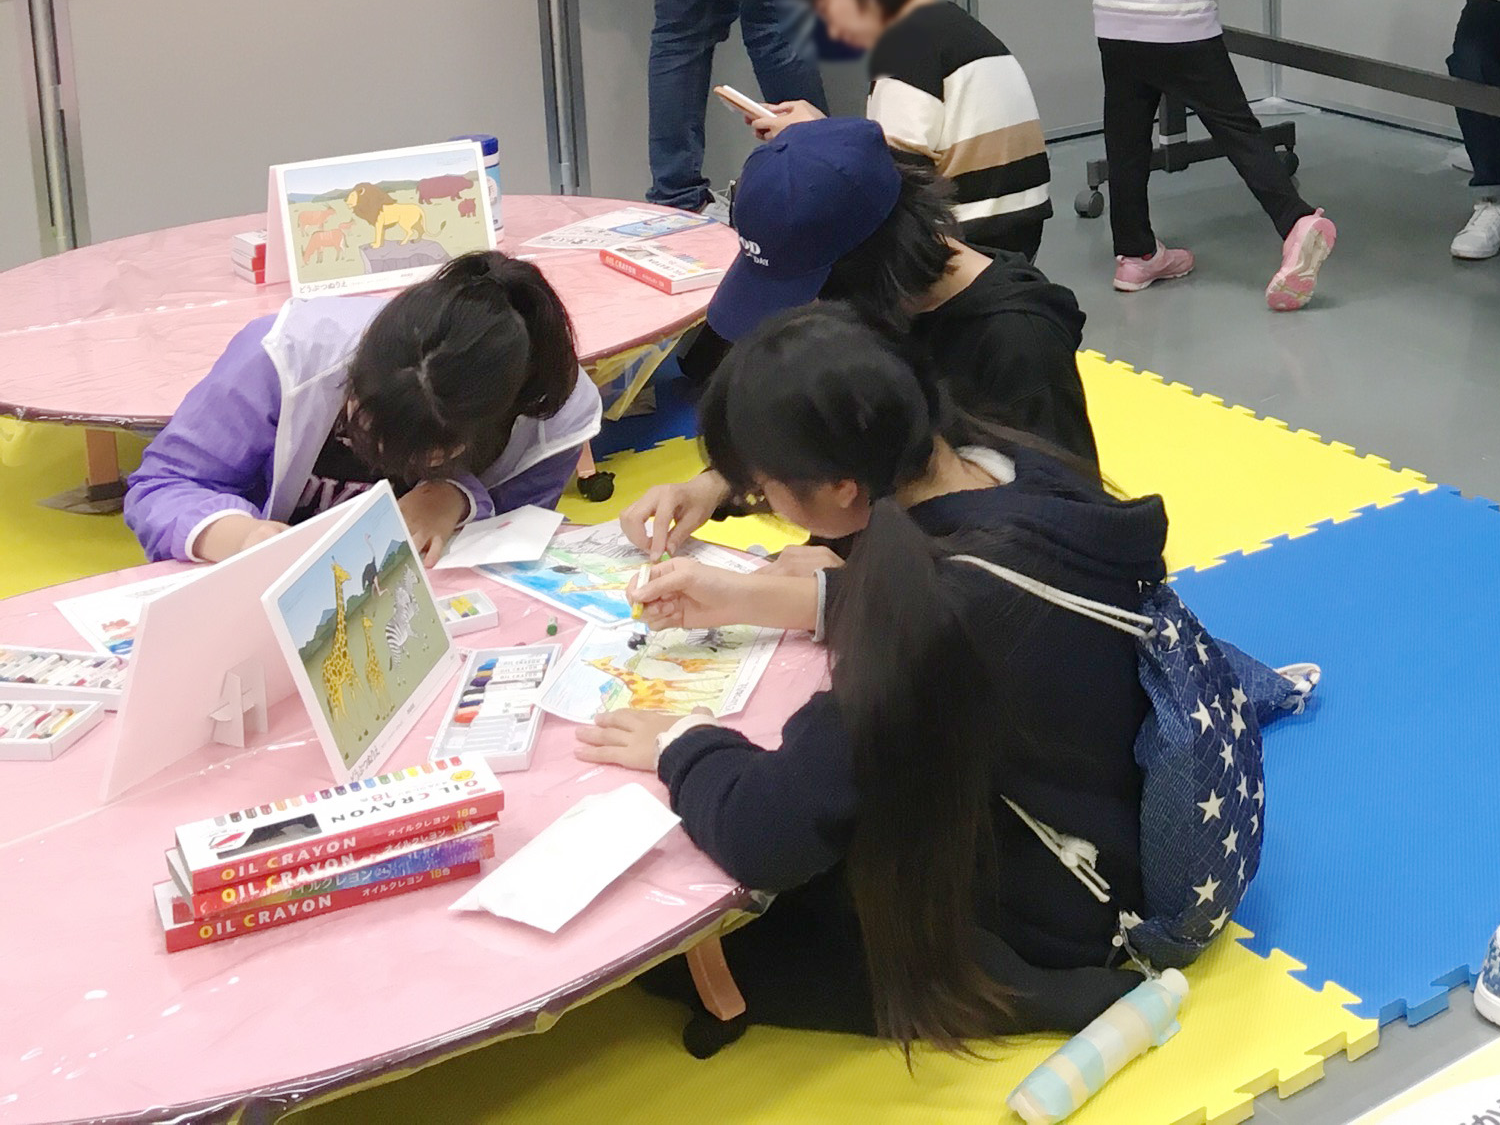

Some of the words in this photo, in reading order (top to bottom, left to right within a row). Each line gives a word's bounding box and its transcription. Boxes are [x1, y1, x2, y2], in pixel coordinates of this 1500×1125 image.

[300, 281, 348, 294] どうぶつぬりえ
[387, 815, 451, 837] オイルクレヨン
[222, 862, 259, 881] OIL
[266, 837, 356, 869] CRAYON
[222, 881, 260, 903] OIL
[266, 853, 355, 889] CRAYON
[362, 875, 424, 896] オイルクレヨン
[200, 920, 237, 939] OIL
[243, 894, 332, 927] CRAYON
